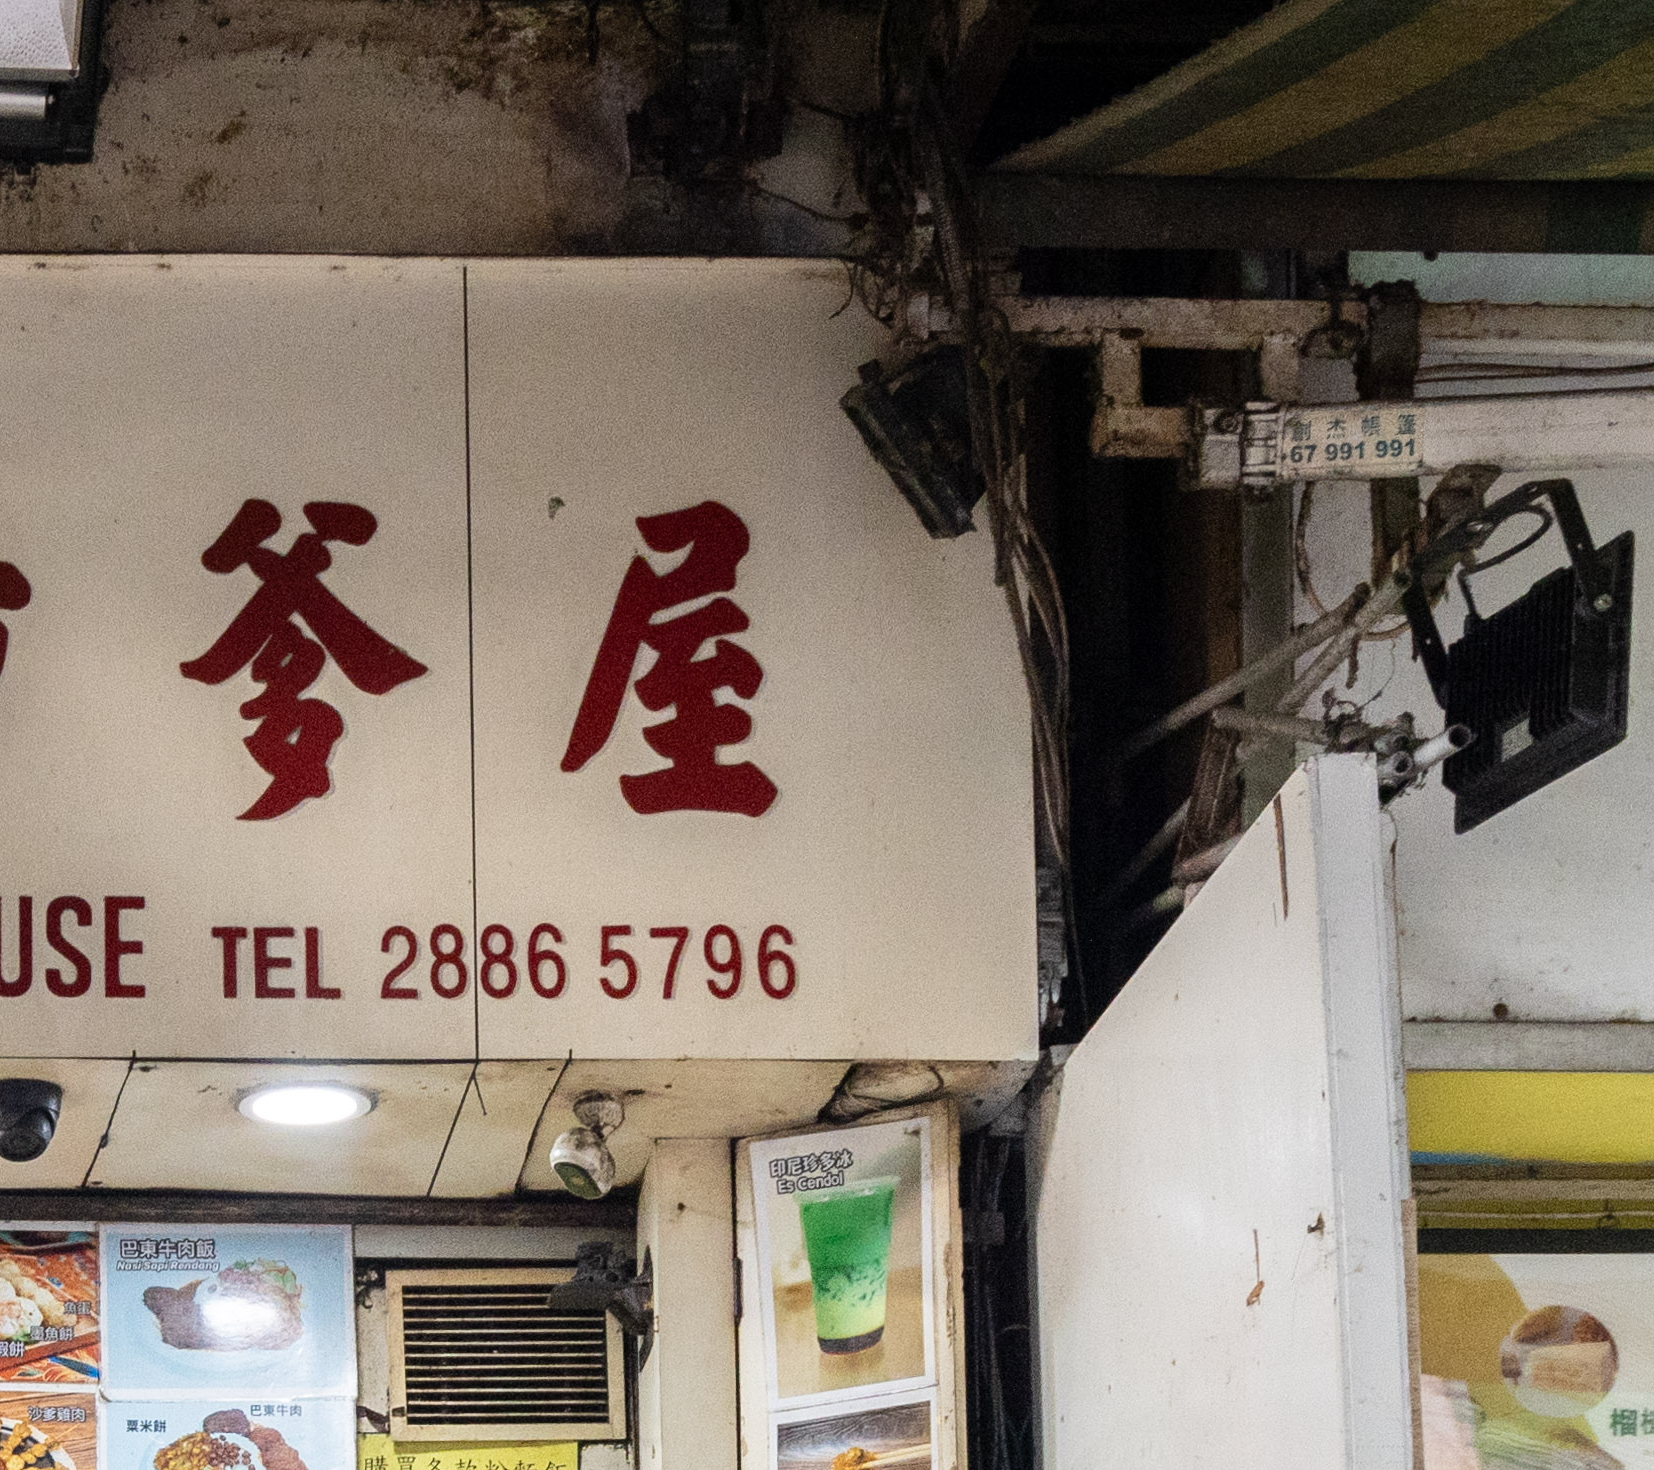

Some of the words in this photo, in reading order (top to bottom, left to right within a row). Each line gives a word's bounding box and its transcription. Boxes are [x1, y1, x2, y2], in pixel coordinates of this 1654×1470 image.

[1290, 445, 1317, 463] 67
[1325, 441, 1365, 461] 991
[1375, 438, 1415, 458] 991
[210, 925, 341, 1000] TEL
[380, 923, 566, 1000] 2886
[599, 923, 797, 1000] 5796
[769, 1149, 854, 1177] 印尼珍多冰
[777, 1178, 795, 1194] Es
[797, 1171, 844, 1191] Cendol
[120, 1239, 216, 1259] 巴東牛肉飯
[27, 1406, 86, 1422] 沙爹雞肉
[250, 1404, 302, 1417] 巴東牛肉
